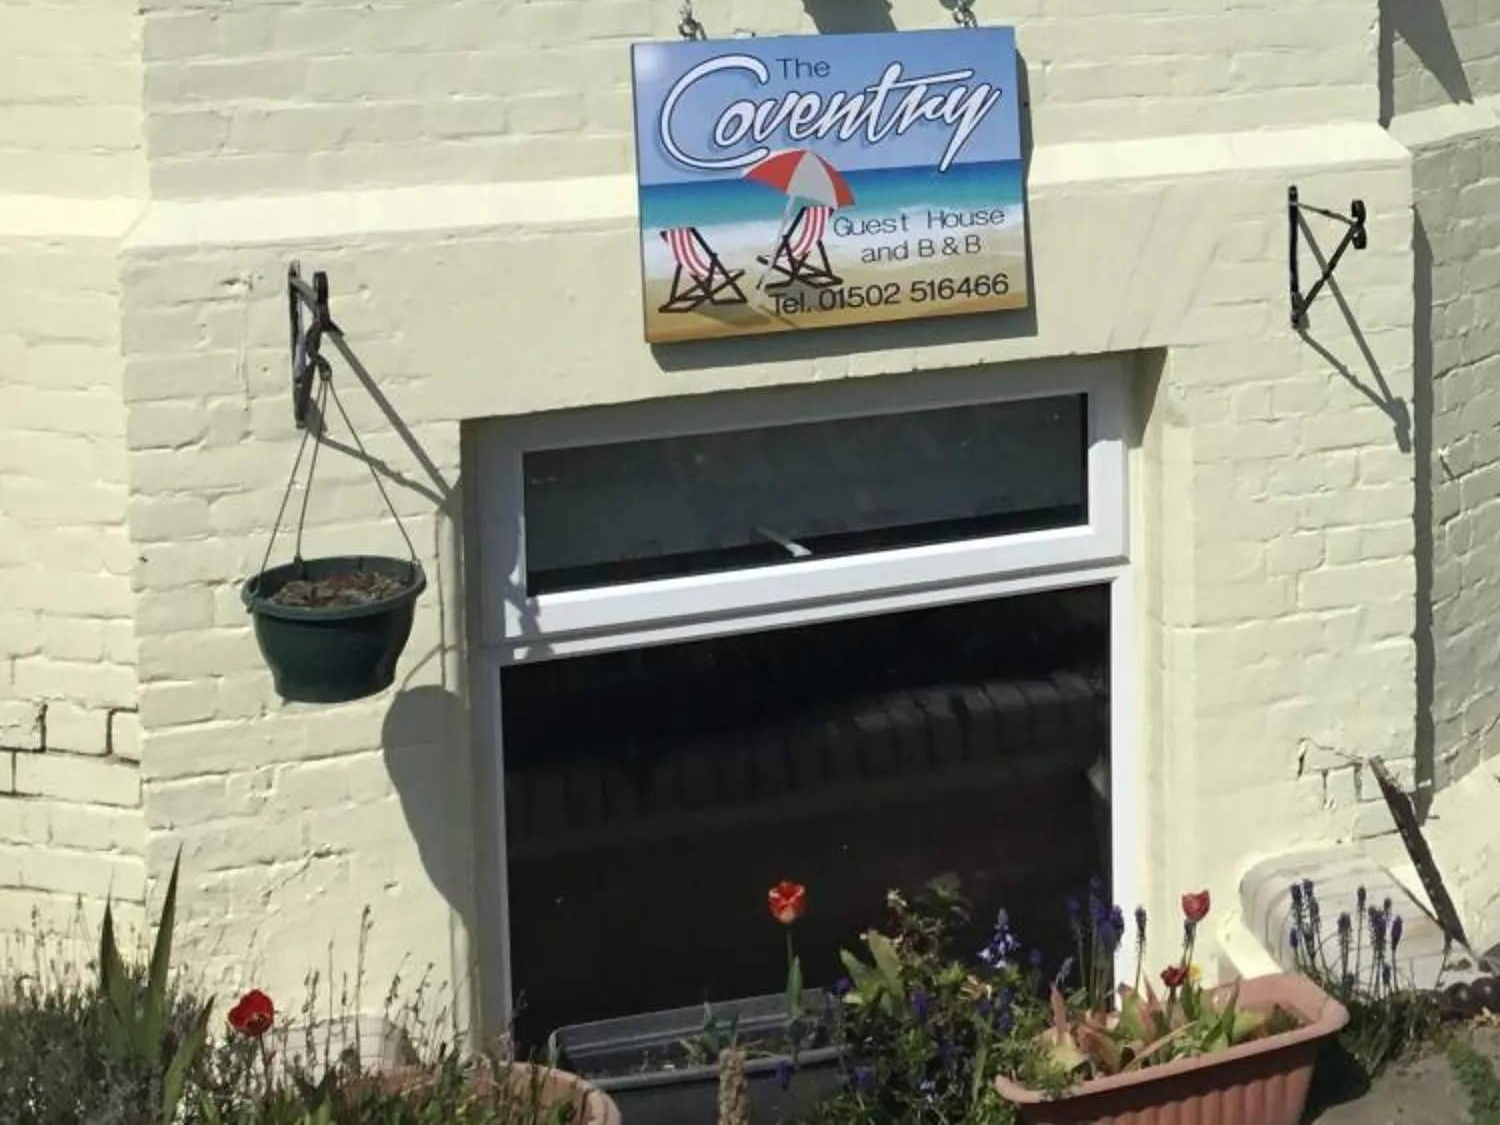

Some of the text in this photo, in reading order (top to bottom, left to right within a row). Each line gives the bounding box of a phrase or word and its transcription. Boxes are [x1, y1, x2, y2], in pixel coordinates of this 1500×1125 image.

[775, 57, 831, 81] The
[659, 52, 1003, 173] Coventry
[832, 208, 1006, 238] Guest House
[860, 233, 982, 264] and B & B
[767, 272, 1010, 317] Tel. 01502 516466
